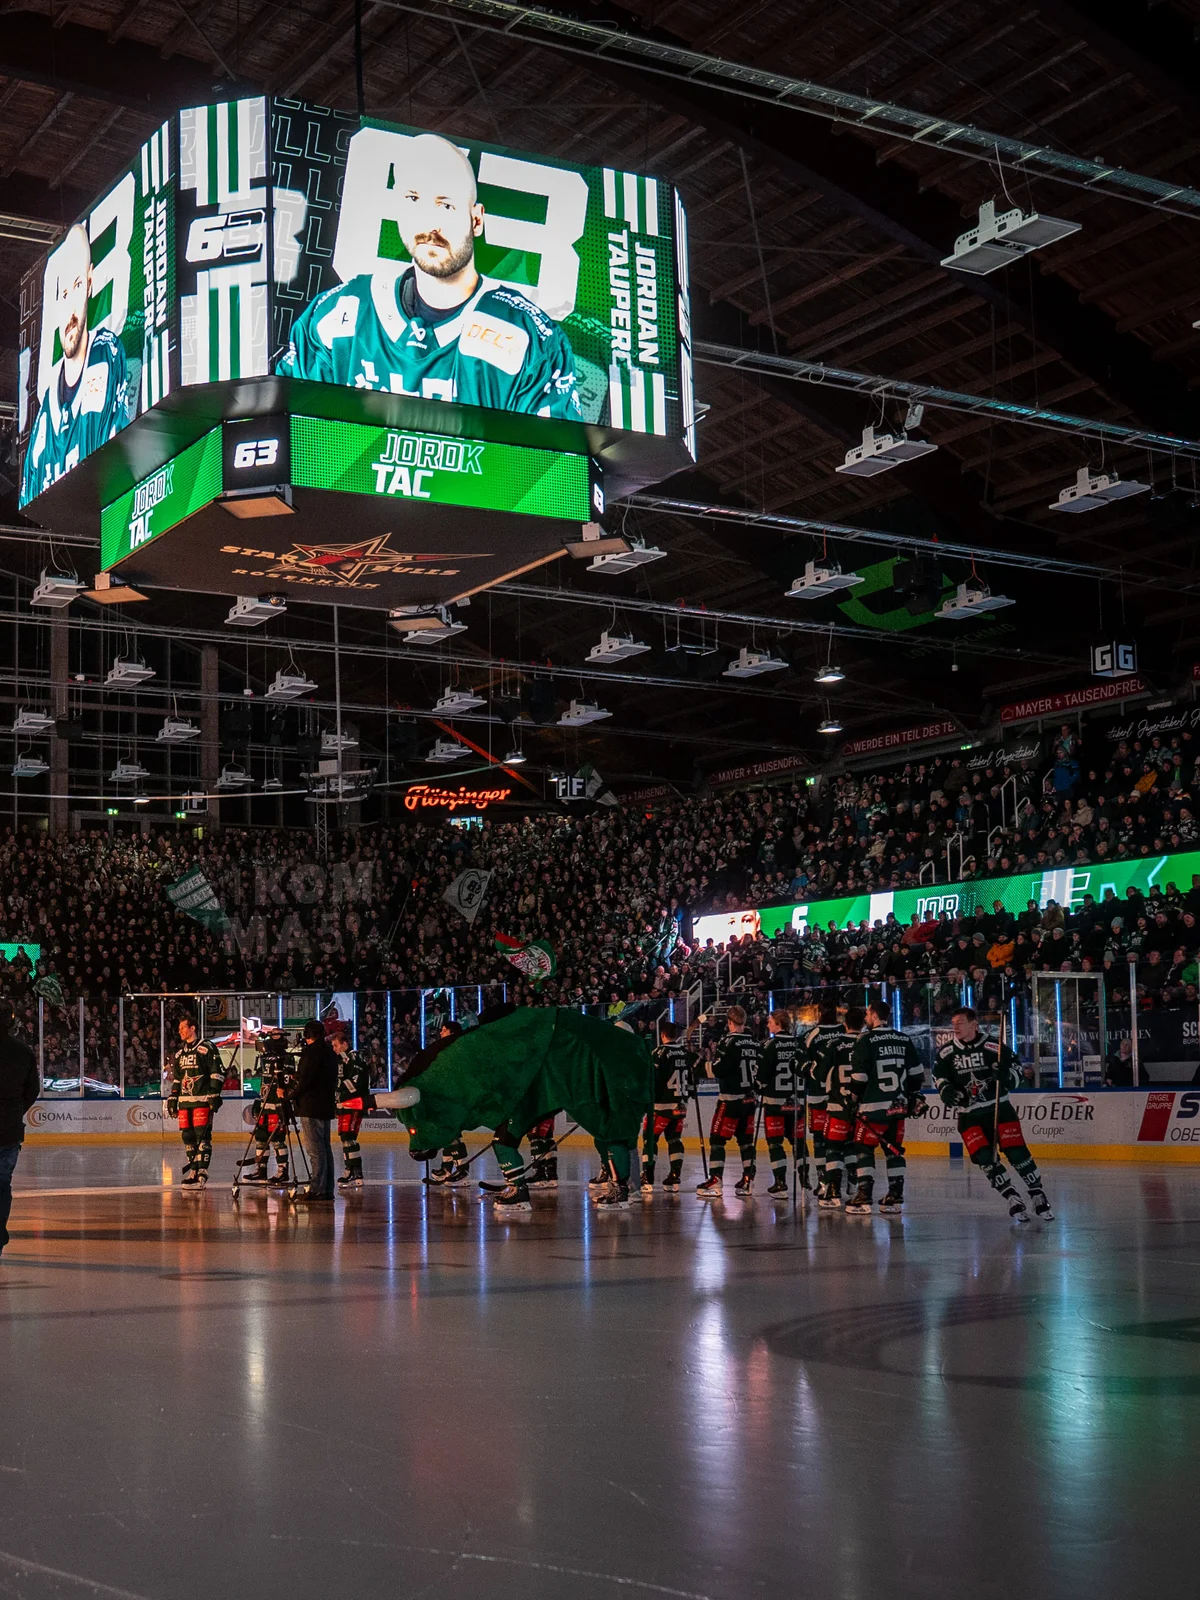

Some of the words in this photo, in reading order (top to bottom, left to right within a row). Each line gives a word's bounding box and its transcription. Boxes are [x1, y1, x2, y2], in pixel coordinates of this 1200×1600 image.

[185, 209, 264, 263] 63
[156, 198, 167, 328] JORDAN
[635, 241, 660, 365] JORDAN
[234, 438, 279, 468] 63
[372, 463, 434, 499] TAC
[219, 545, 300, 562] STAR
[371, 565, 461, 576] BULLS
[1015, 698, 1052, 717] MAYER
[853, 737, 884, 754] WERDE
[885, 734, 900, 748] EIN
[901, 730, 920, 745] TEIL
[922, 726, 938, 740] DES
[572, 778, 584, 796] F
[718, 767, 744, 783] MAYER
[38, 1112, 73, 1122] ISOMA
[1016, 1105, 1047, 1120] UTO
[1050, 1101, 1095, 1120] EDER
[1032, 1124, 1065, 1137] Gruppe
